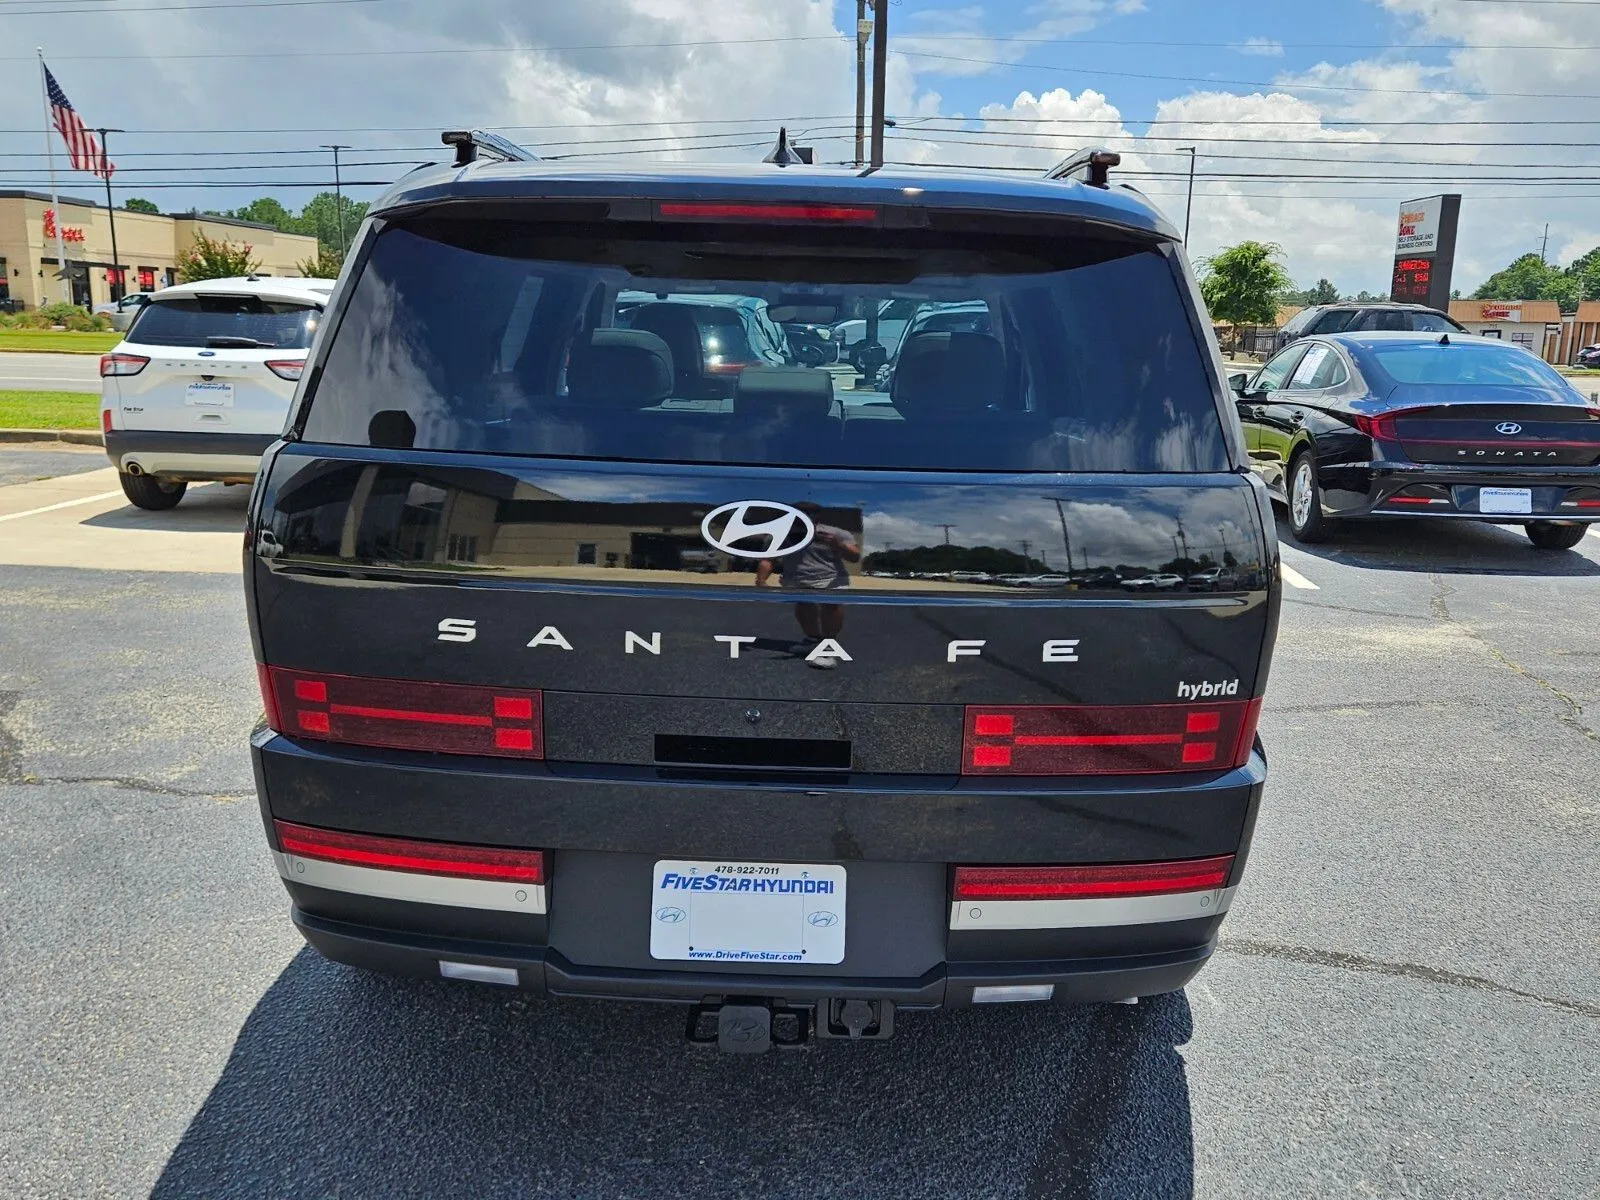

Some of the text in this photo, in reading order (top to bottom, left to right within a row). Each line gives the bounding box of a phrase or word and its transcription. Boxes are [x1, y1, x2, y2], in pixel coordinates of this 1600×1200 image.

[438, 618, 1080, 662] SANTA FE
[1177, 679, 1239, 698] hybrid
[714, 865, 780, 875] 478-922-7011
[689, 950, 803, 961] www.DriveFiveStar.com
